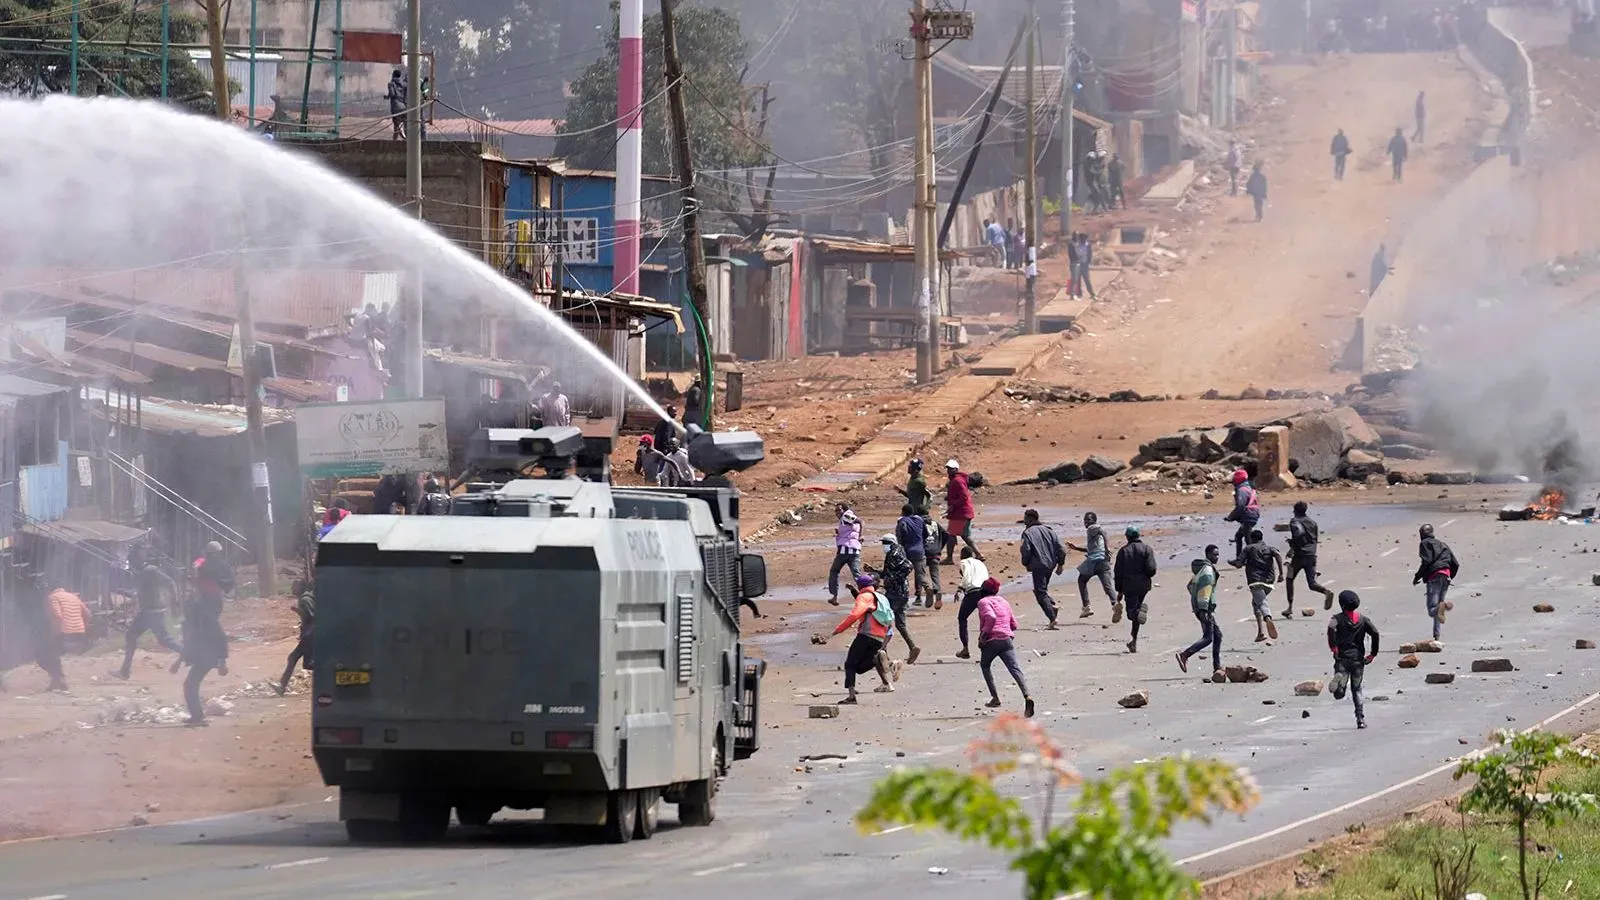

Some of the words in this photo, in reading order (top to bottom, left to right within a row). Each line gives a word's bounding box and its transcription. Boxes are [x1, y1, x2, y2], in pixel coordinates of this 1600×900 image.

[343, 420, 396, 432] KALRO
[392, 627, 522, 655] POLICE
[549, 705, 585, 714] MOTORS
